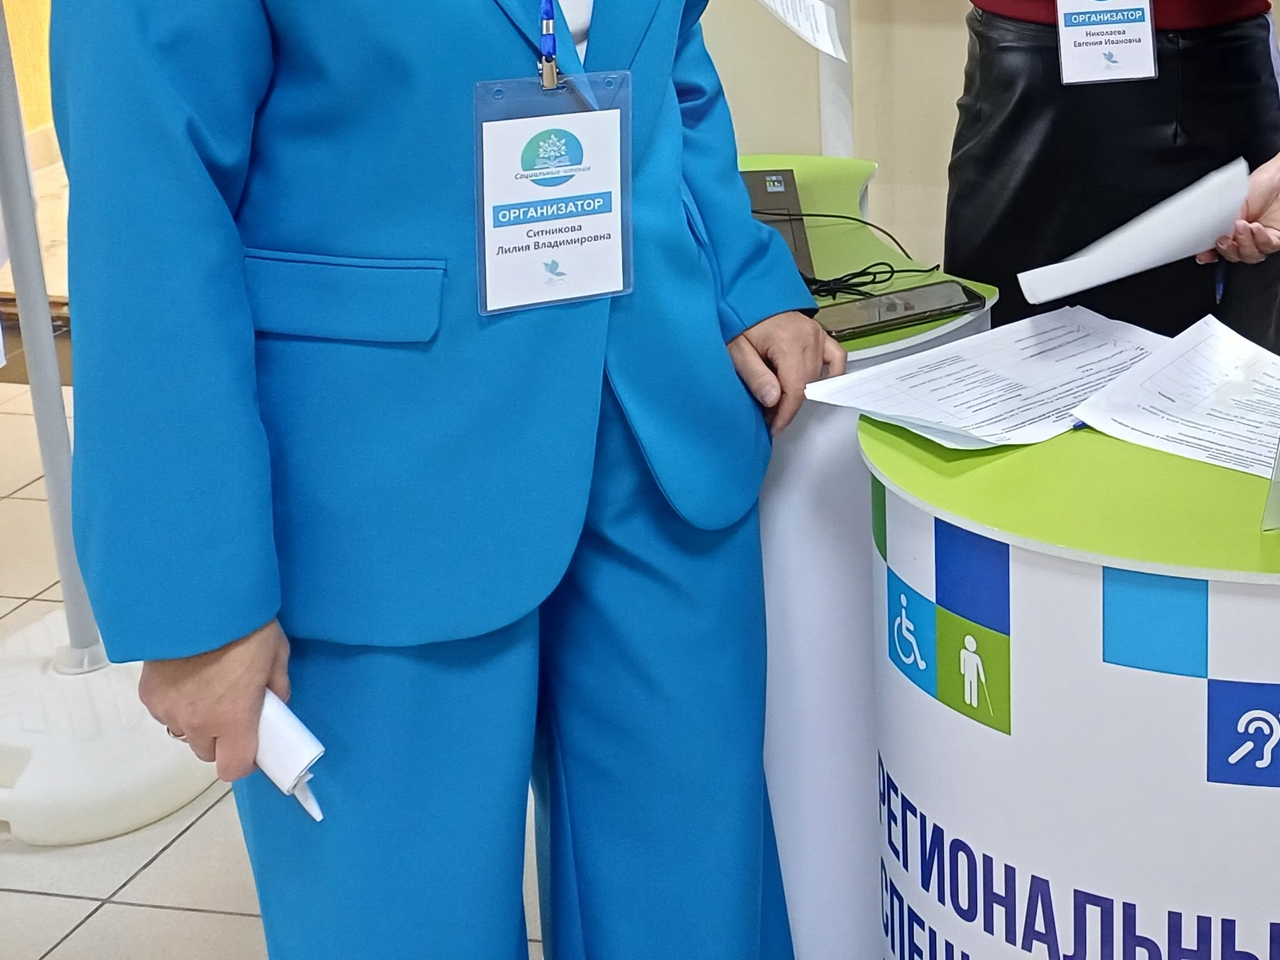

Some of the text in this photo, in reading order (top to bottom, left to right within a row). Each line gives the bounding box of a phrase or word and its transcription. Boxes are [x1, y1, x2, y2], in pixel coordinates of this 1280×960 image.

[1071, 10, 1143, 24] ОРГАНИЗАТОР
[1085, 29, 1126, 38] Николаева
[1073, 37, 1142, 48] Евгения Ивановна
[498, 198, 604, 223] ОРГАНИЗАТОР
[526, 224, 583, 239] Ситникова
[496, 232, 612, 256] Лилия Владимировна
